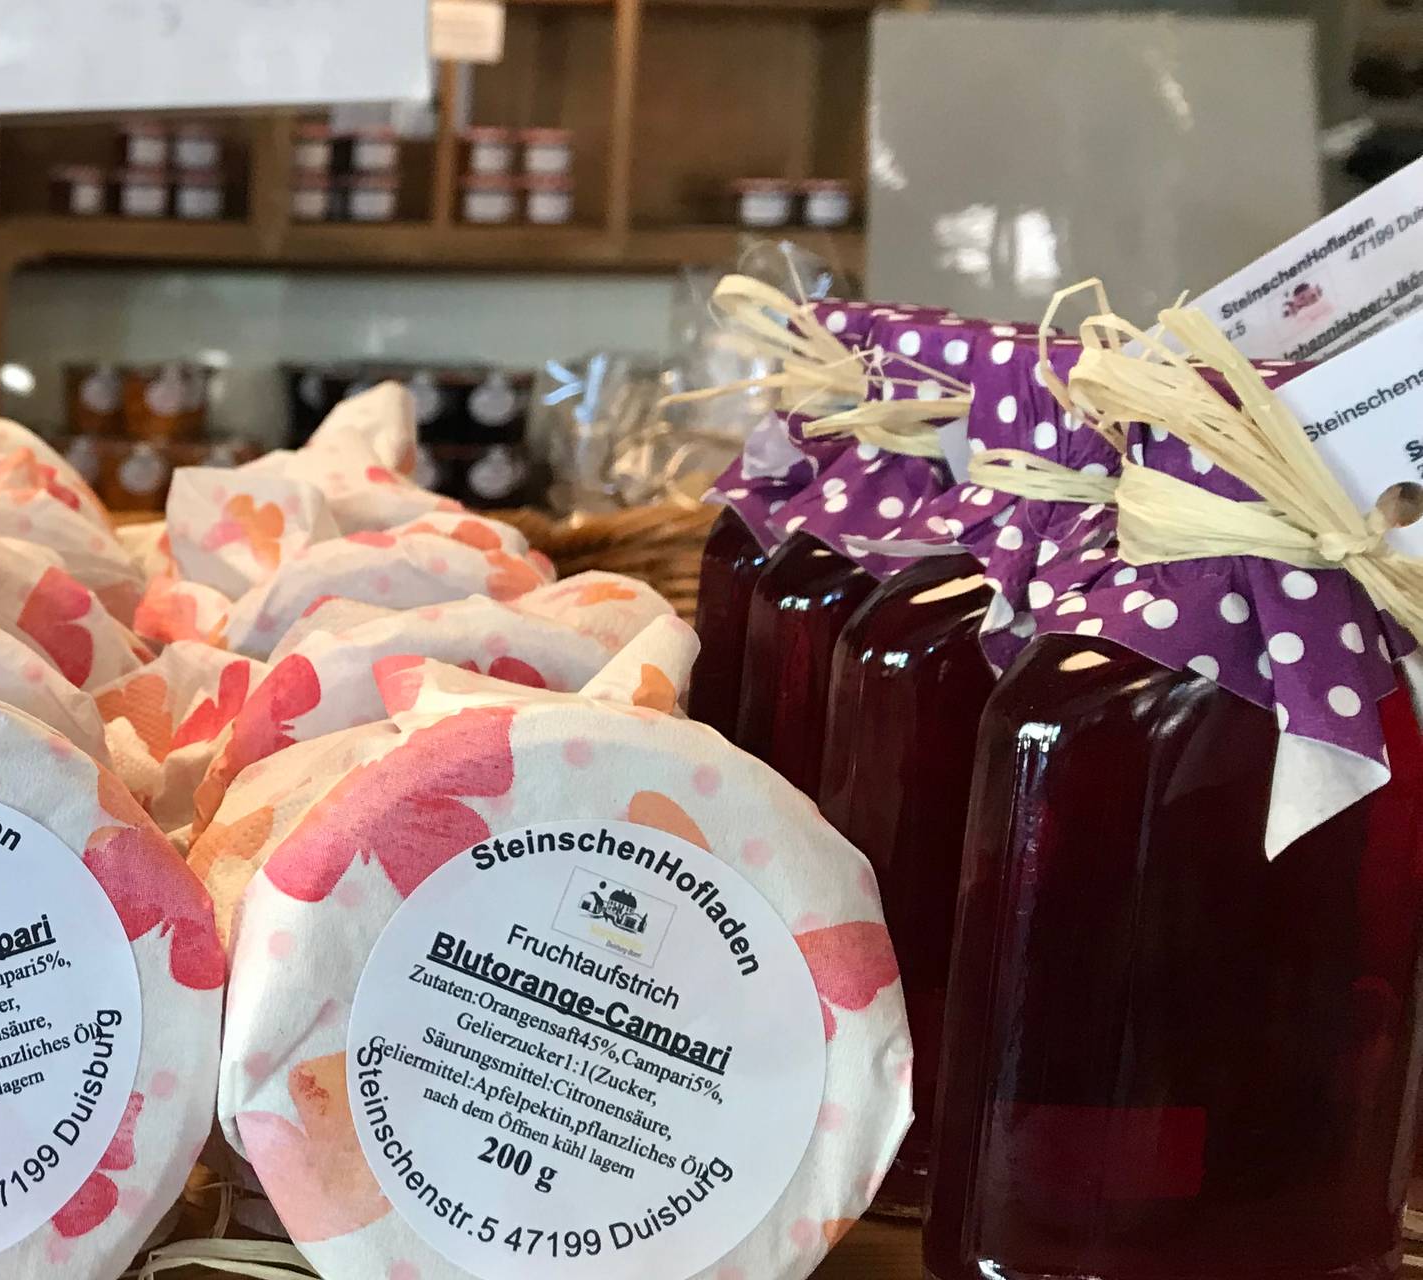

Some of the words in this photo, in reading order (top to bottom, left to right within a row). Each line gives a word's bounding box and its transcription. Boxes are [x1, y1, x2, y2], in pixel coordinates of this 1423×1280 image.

[471, 828, 760, 976] SteinschenHofladen
[426, 931, 733, 1075] Blutorange-Campari
[507, 924, 680, 1010] Fruchtaufstrich
[53, 1008, 122, 1146] Duisburg
[422, 1026, 672, 1142] Säurungsmittel:Citronensäure,
[456, 1012, 658, 1107] Gelierzucker1:1(Zucker,
[357, 1046, 499, 1243] Steinschenstr.5
[504, 1227, 602, 1258] 47199
[609, 1156, 733, 1250] Duisburg
[423, 1085, 459, 1112] nach
[461, 1100, 494, 1125] dem
[498, 1111, 548, 1146] Öffnen
[552, 1134, 586, 1160] kühl
[588, 1149, 636, 1179] lagern
[478, 1136, 532, 1177] 200
[535, 1165, 558, 1193] g
